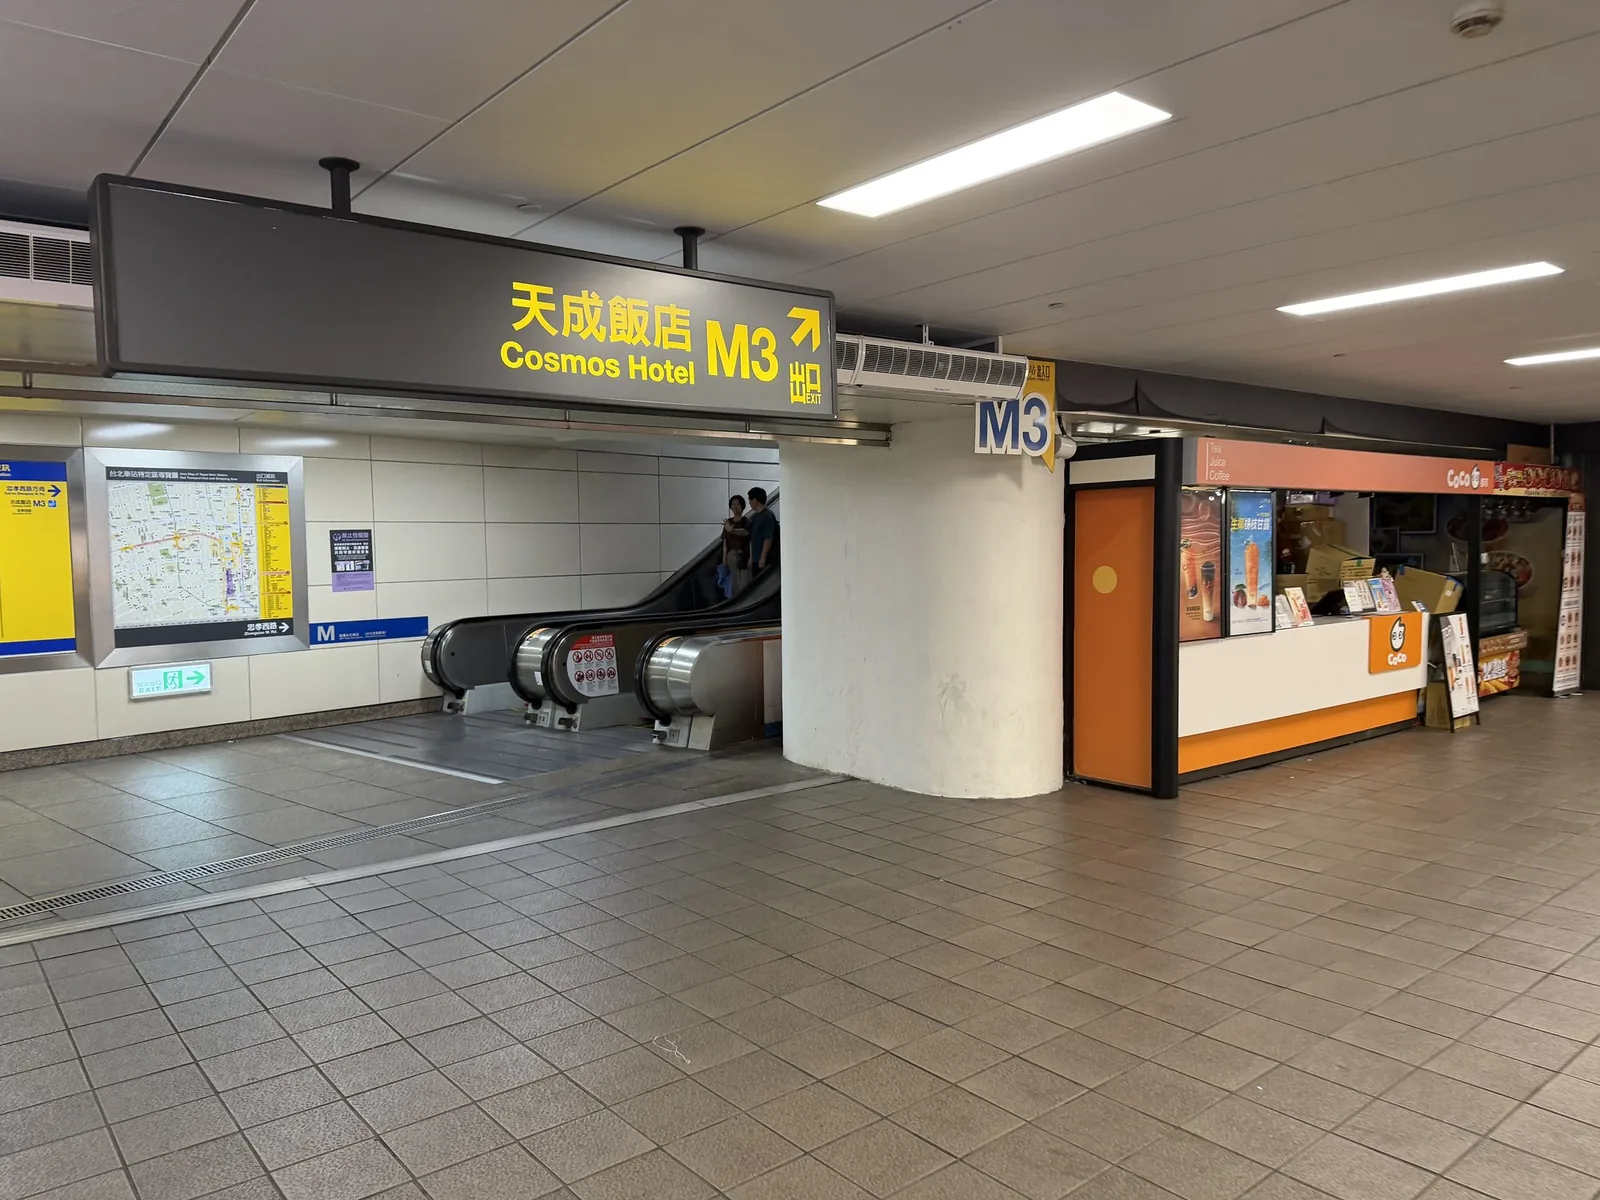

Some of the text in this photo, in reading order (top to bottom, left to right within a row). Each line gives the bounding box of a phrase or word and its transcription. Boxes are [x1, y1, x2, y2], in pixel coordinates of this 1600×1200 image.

[511, 281, 692, 352] 天成飯店
[706, 319, 779, 382] M3
[500, 340, 695, 385] Cosmos Hotel
[789, 361, 822, 404] 出口
[806, 392, 822, 404] EXIT
[977, 397, 1049, 452] M3
[1210, 442, 1222, 453] Tea
[1209, 457, 1226, 467] Juice
[1209, 470, 1230, 481] Coffee
[1446, 468, 1470, 489] CoCo
[246, 621, 278, 632] 忠孝西路
[317, 625, 336, 642] M
[1387, 652, 1407, 666] CoCo
